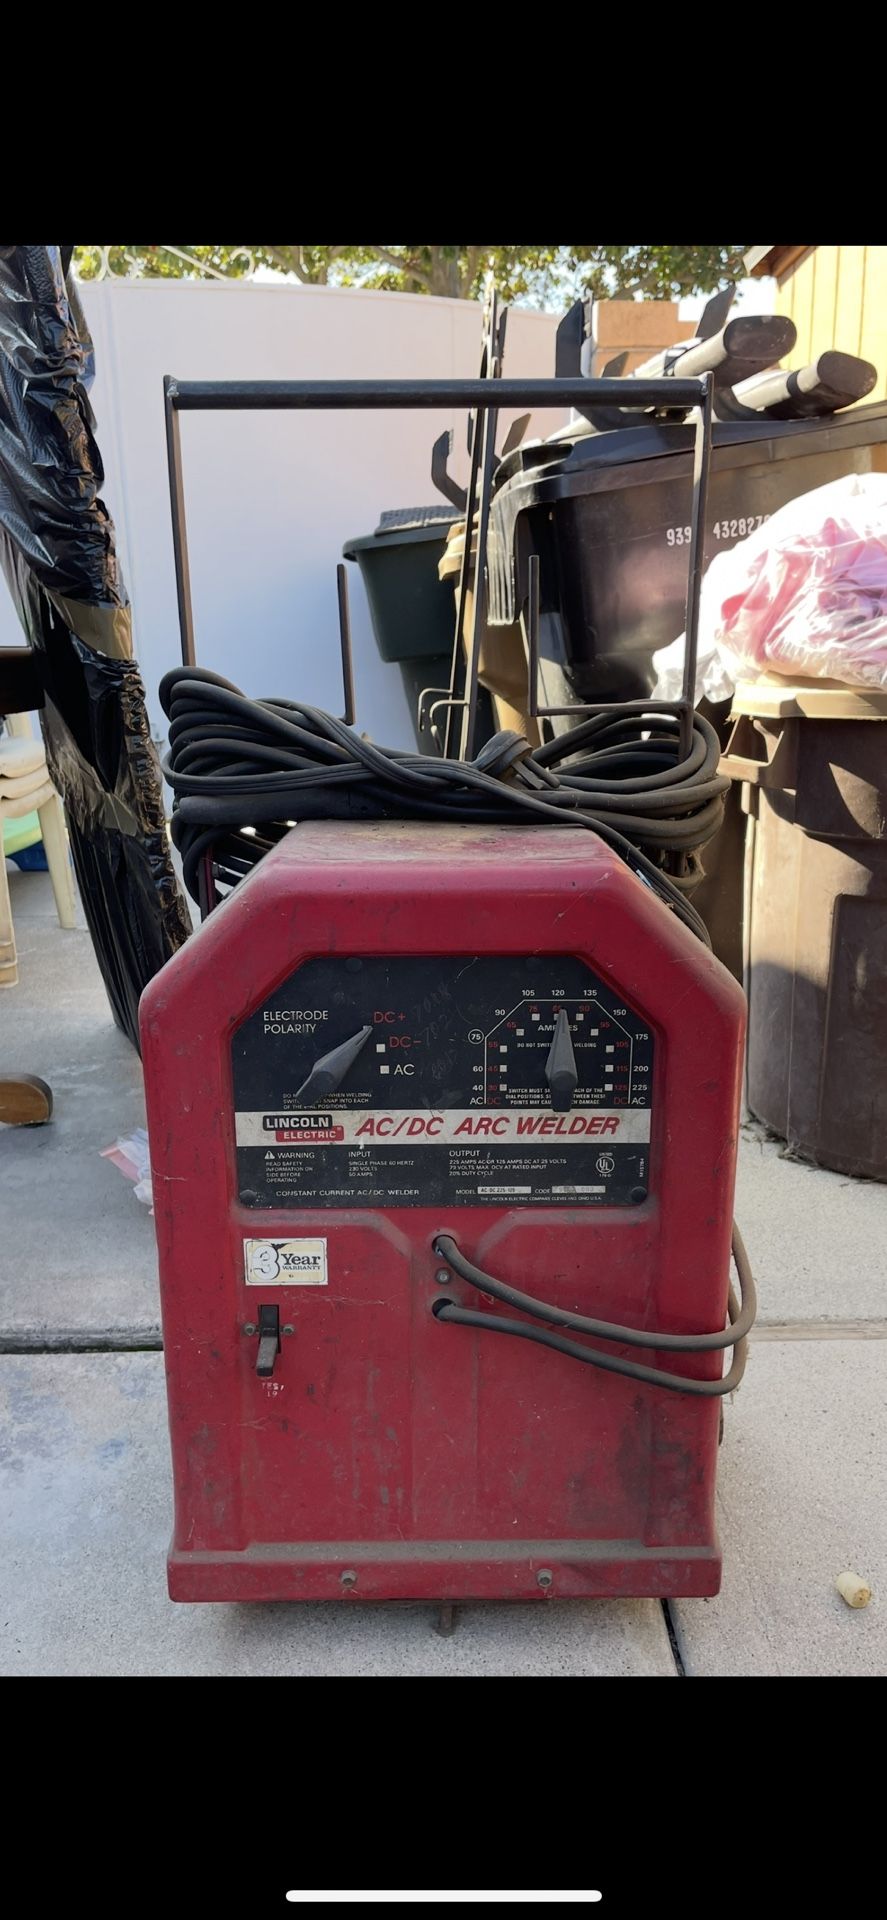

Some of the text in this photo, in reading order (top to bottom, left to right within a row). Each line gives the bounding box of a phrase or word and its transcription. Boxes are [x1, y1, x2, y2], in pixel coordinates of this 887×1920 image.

[713, 514, 771, 540] 432827
[521, 989, 536, 997] 105
[551, 989, 565, 997] 120
[583, 989, 598, 997] 135
[263, 1010, 329, 1021] ELECTRODE
[494, 1008, 506, 1016] 90
[264, 1024, 317, 1034] POLARITY
[471, 1033, 482, 1041] 75
[635, 1033, 649, 1041] 175
[393, 1063, 416, 1076] AC
[472, 1065, 484, 1073] 60
[470, 1096, 484, 1105] AC
[487, 1096, 501, 1105] DC
[613, 1096, 628, 1105] DC
[631, 1096, 646, 1105] AC
[266, 1116, 329, 1129] LINCOLN
[354, 1116, 621, 1137] AC/DC ARC WELDER
[283, 1130, 337, 1140] ELECTRIC
[253, 1244, 321, 1281] 3 Year
